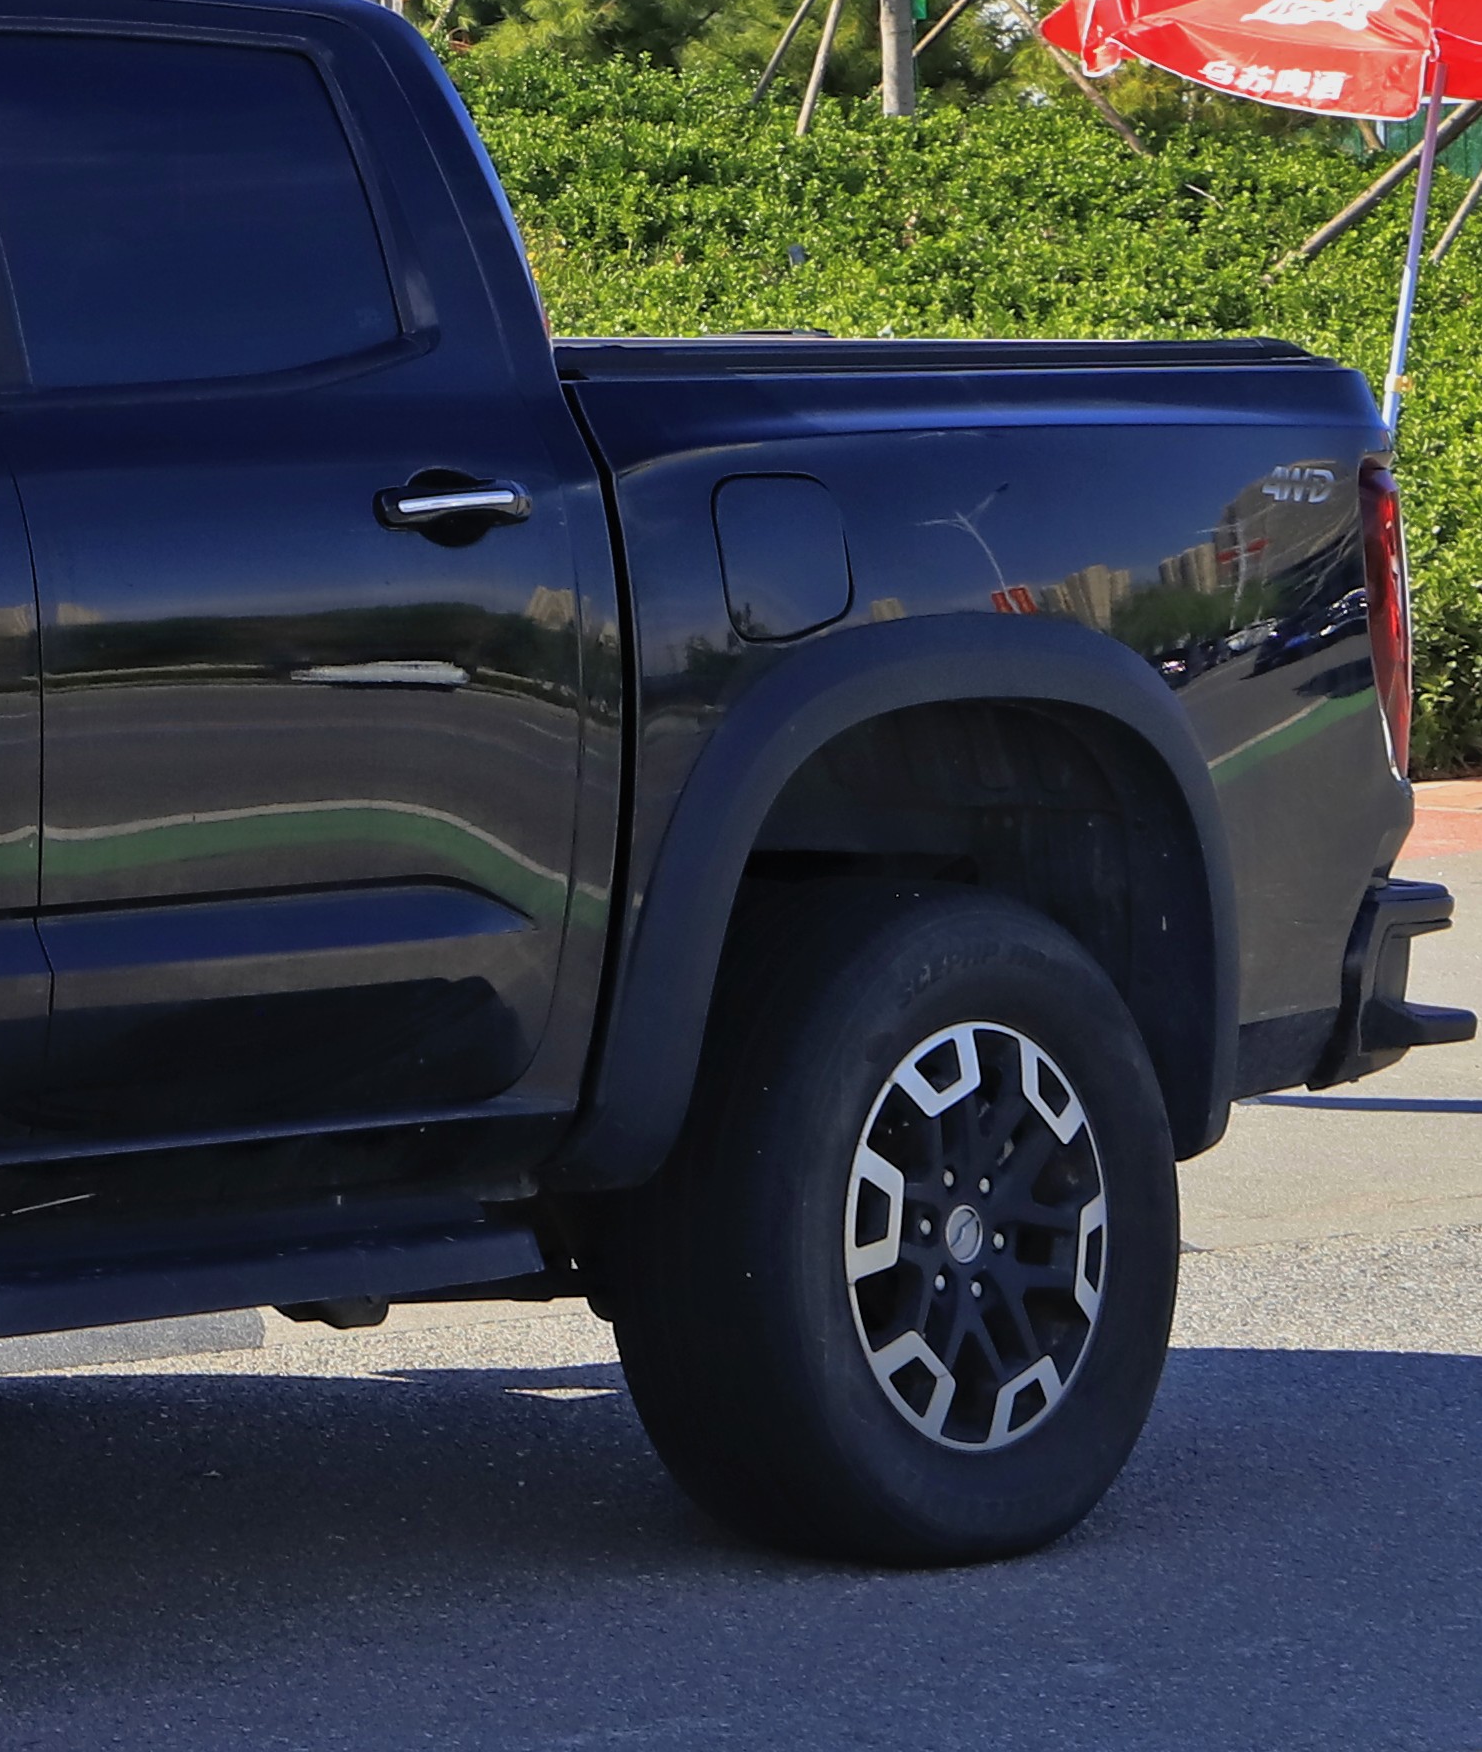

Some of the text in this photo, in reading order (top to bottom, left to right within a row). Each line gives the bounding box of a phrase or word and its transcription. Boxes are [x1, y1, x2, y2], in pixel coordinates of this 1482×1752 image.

[1197, 59, 1353, 100] 乌苏啤酒
[1260, 465, 1336, 503] 4WD
